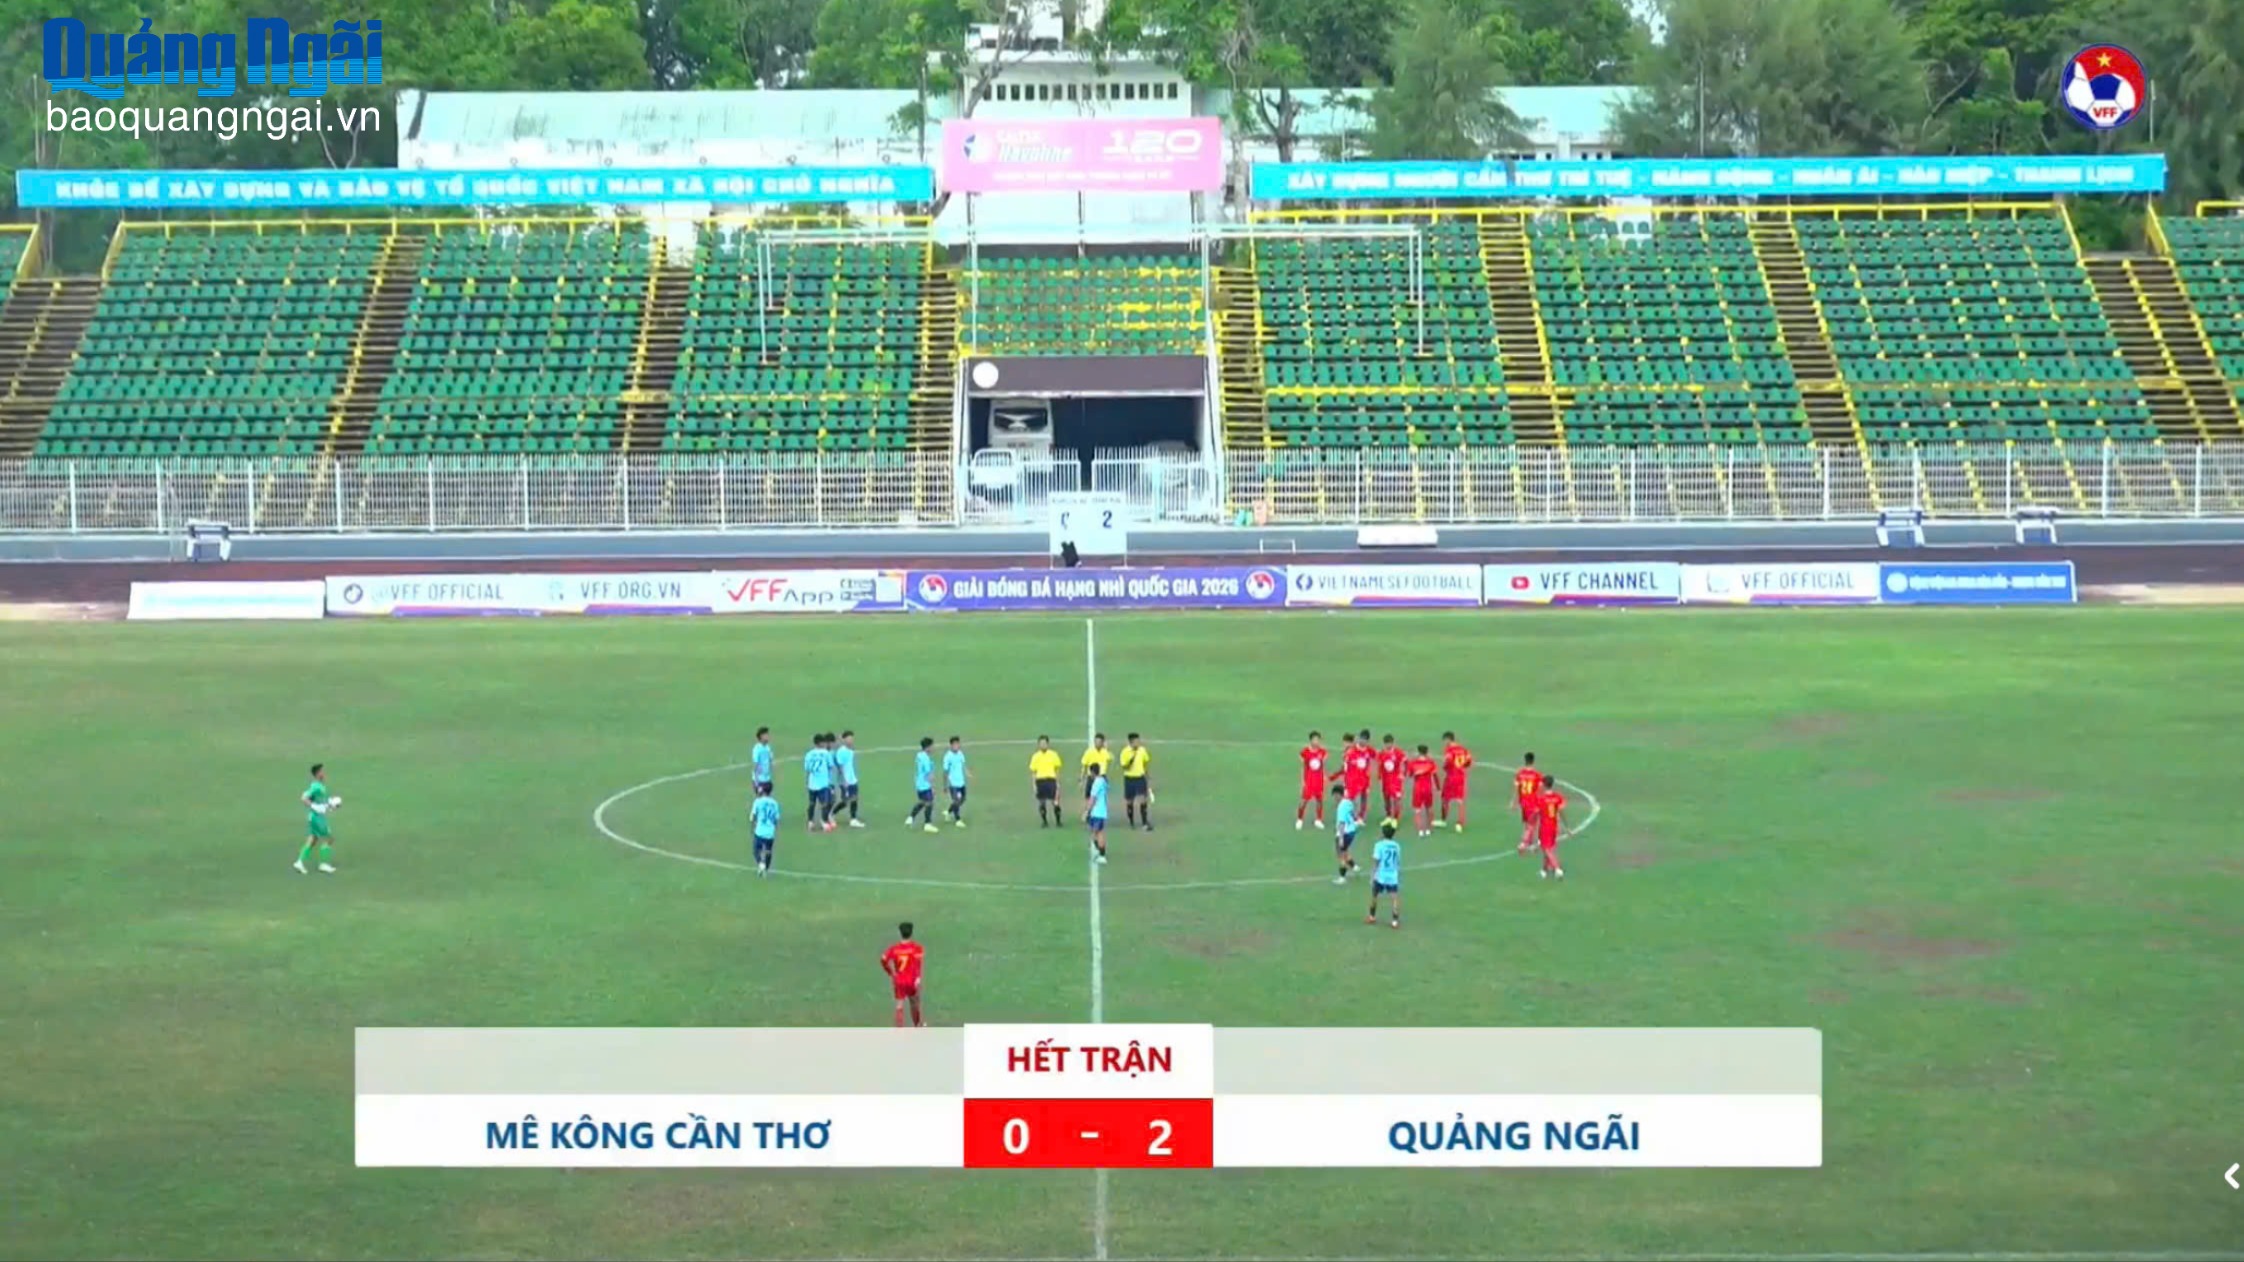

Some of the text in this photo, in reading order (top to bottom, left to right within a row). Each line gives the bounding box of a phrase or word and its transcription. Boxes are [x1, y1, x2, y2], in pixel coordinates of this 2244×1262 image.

[1102, 129, 1202, 155] 120
[1102, 510, 1112, 529] 2
[987, 577, 1028, 599] BÓNG
[1055, 580, 1096, 601] HẠNG
[1129, 575, 1170, 599] QUỐC
[1173, 579, 1199, 597] GIA
[1540, 571, 1659, 590] VFF CHANNEL
[1742, 571, 1854, 589] VFF OFFICIAL
[429, 582, 505, 600] OFFICIAL
[897, 955, 909, 972] 7
